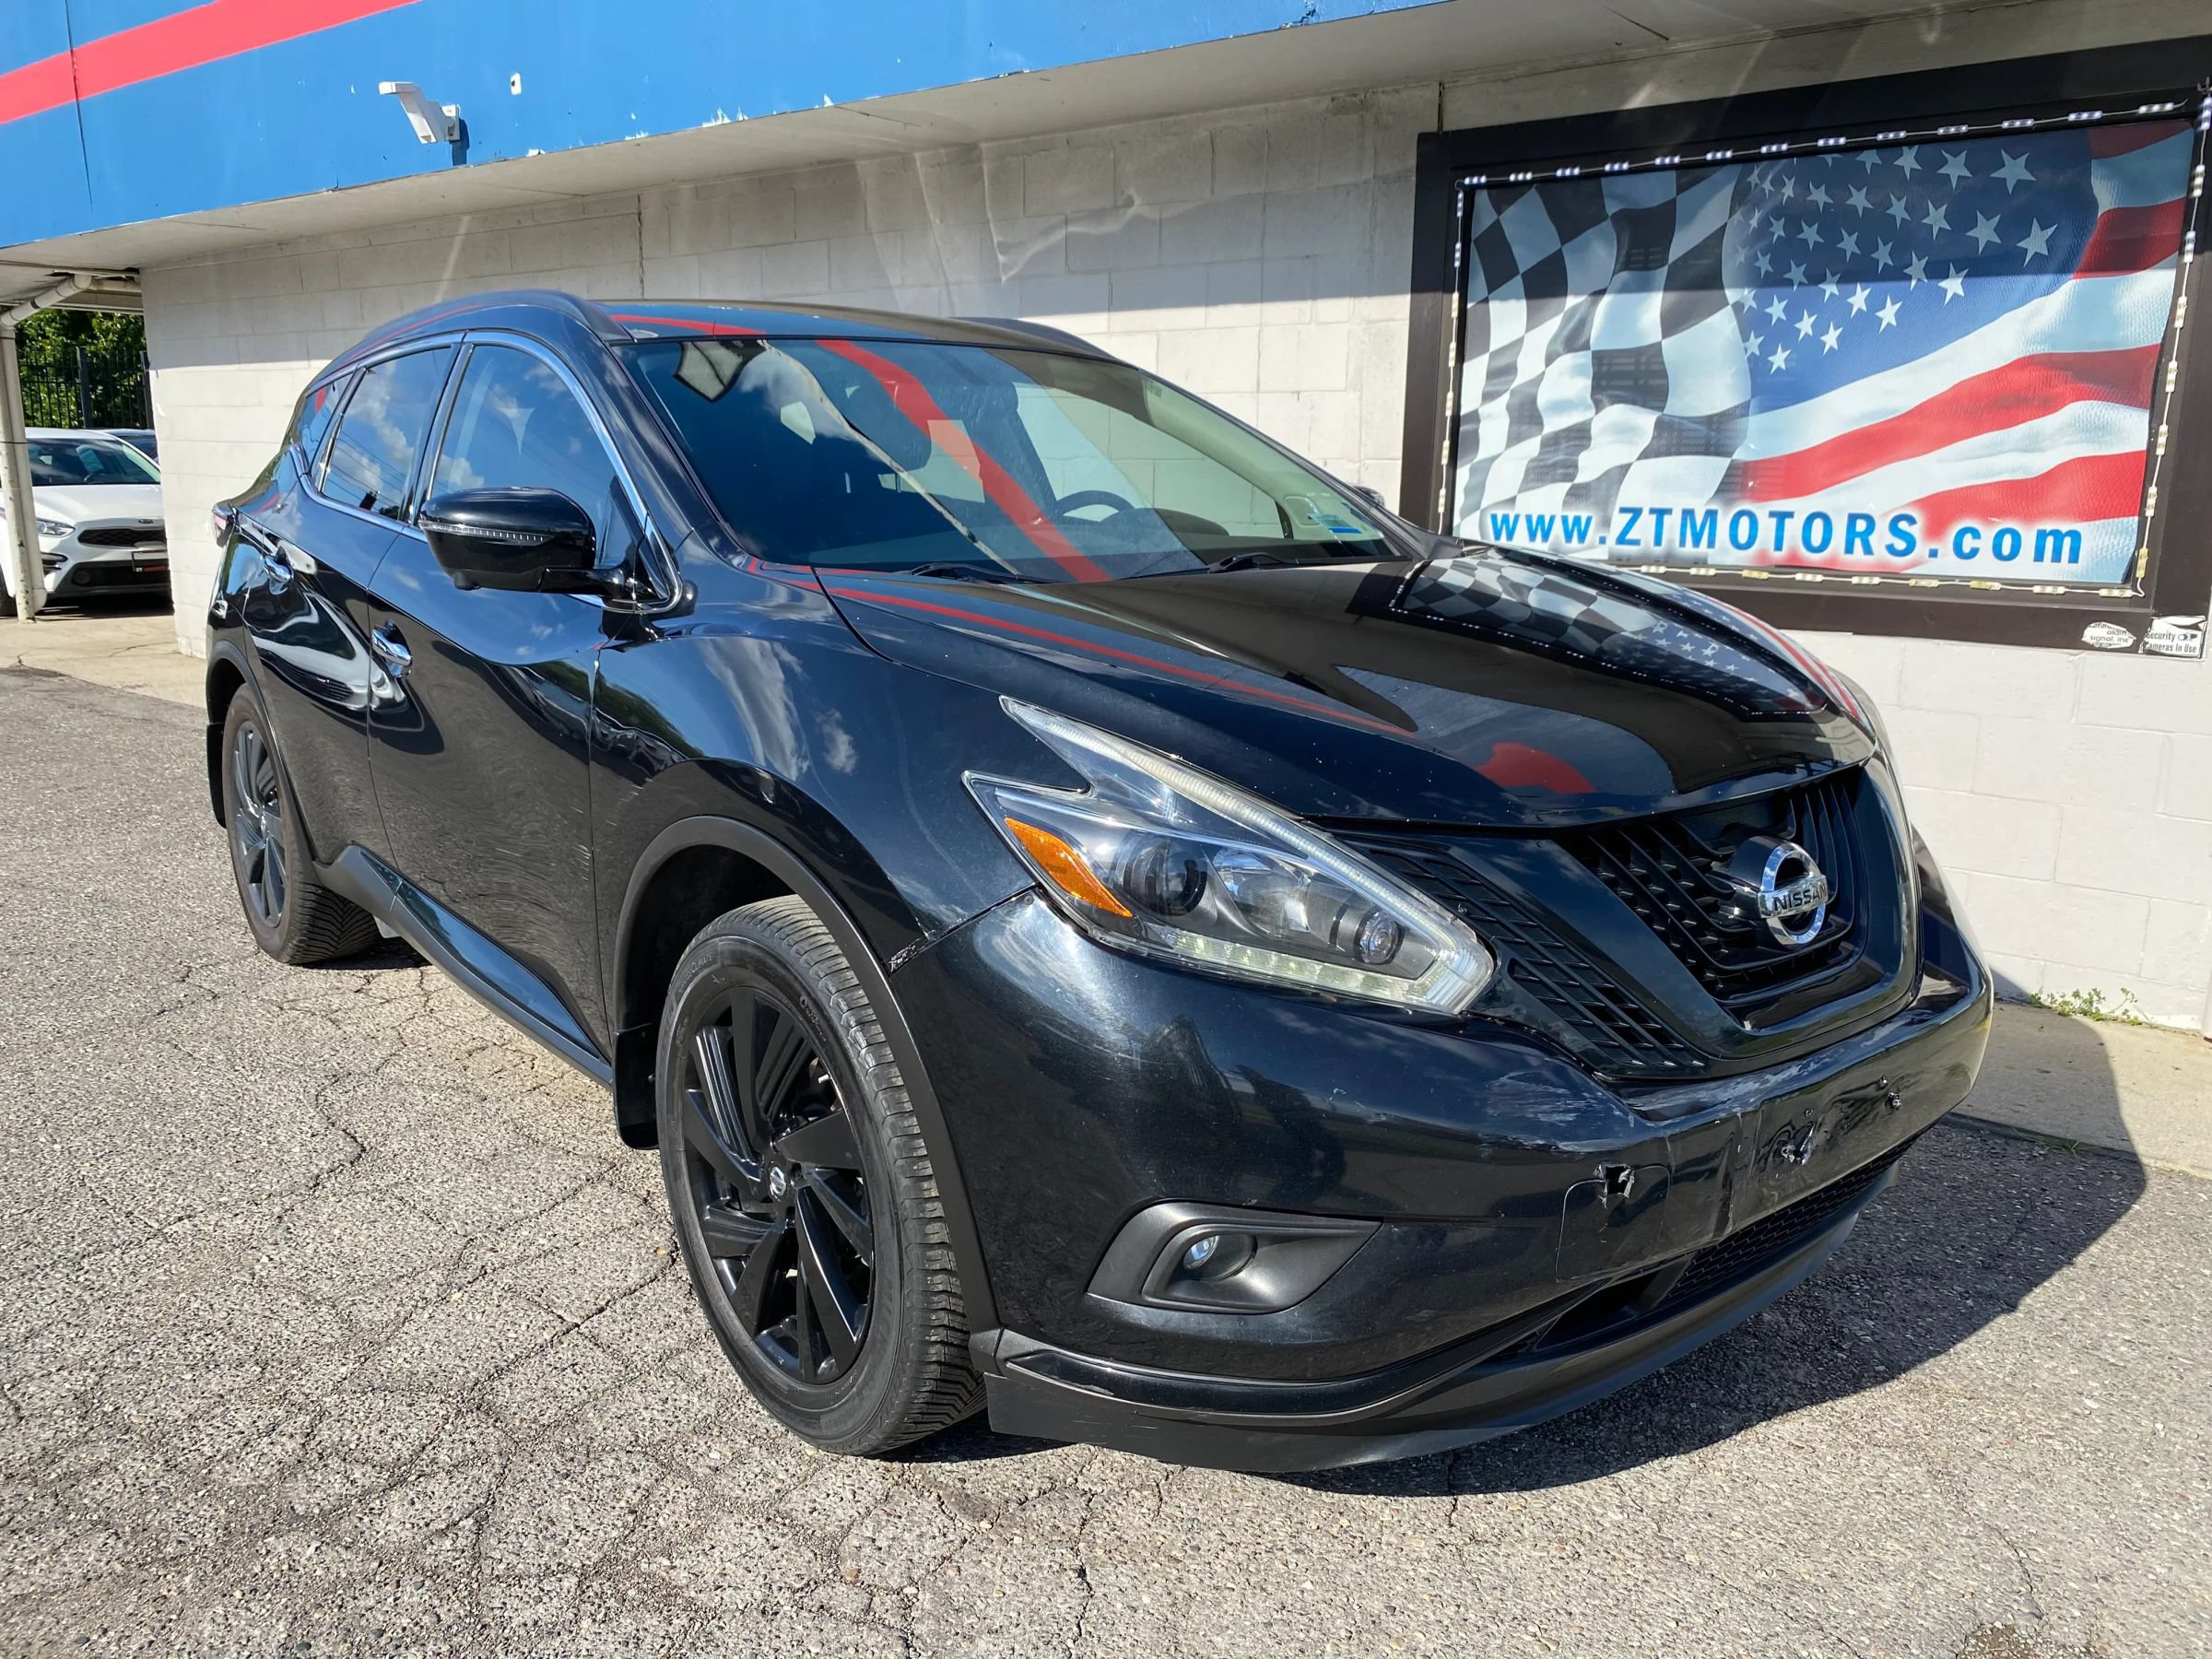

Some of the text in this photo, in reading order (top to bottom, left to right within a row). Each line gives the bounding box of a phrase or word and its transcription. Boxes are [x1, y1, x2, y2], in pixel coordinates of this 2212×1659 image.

[1489, 506, 2083, 565] www.ZTMOTORS.com
[2146, 641, 2174, 652] ameras
[2183, 643, 2197, 653] Use
[1773, 884, 1827, 912] NISSAN
